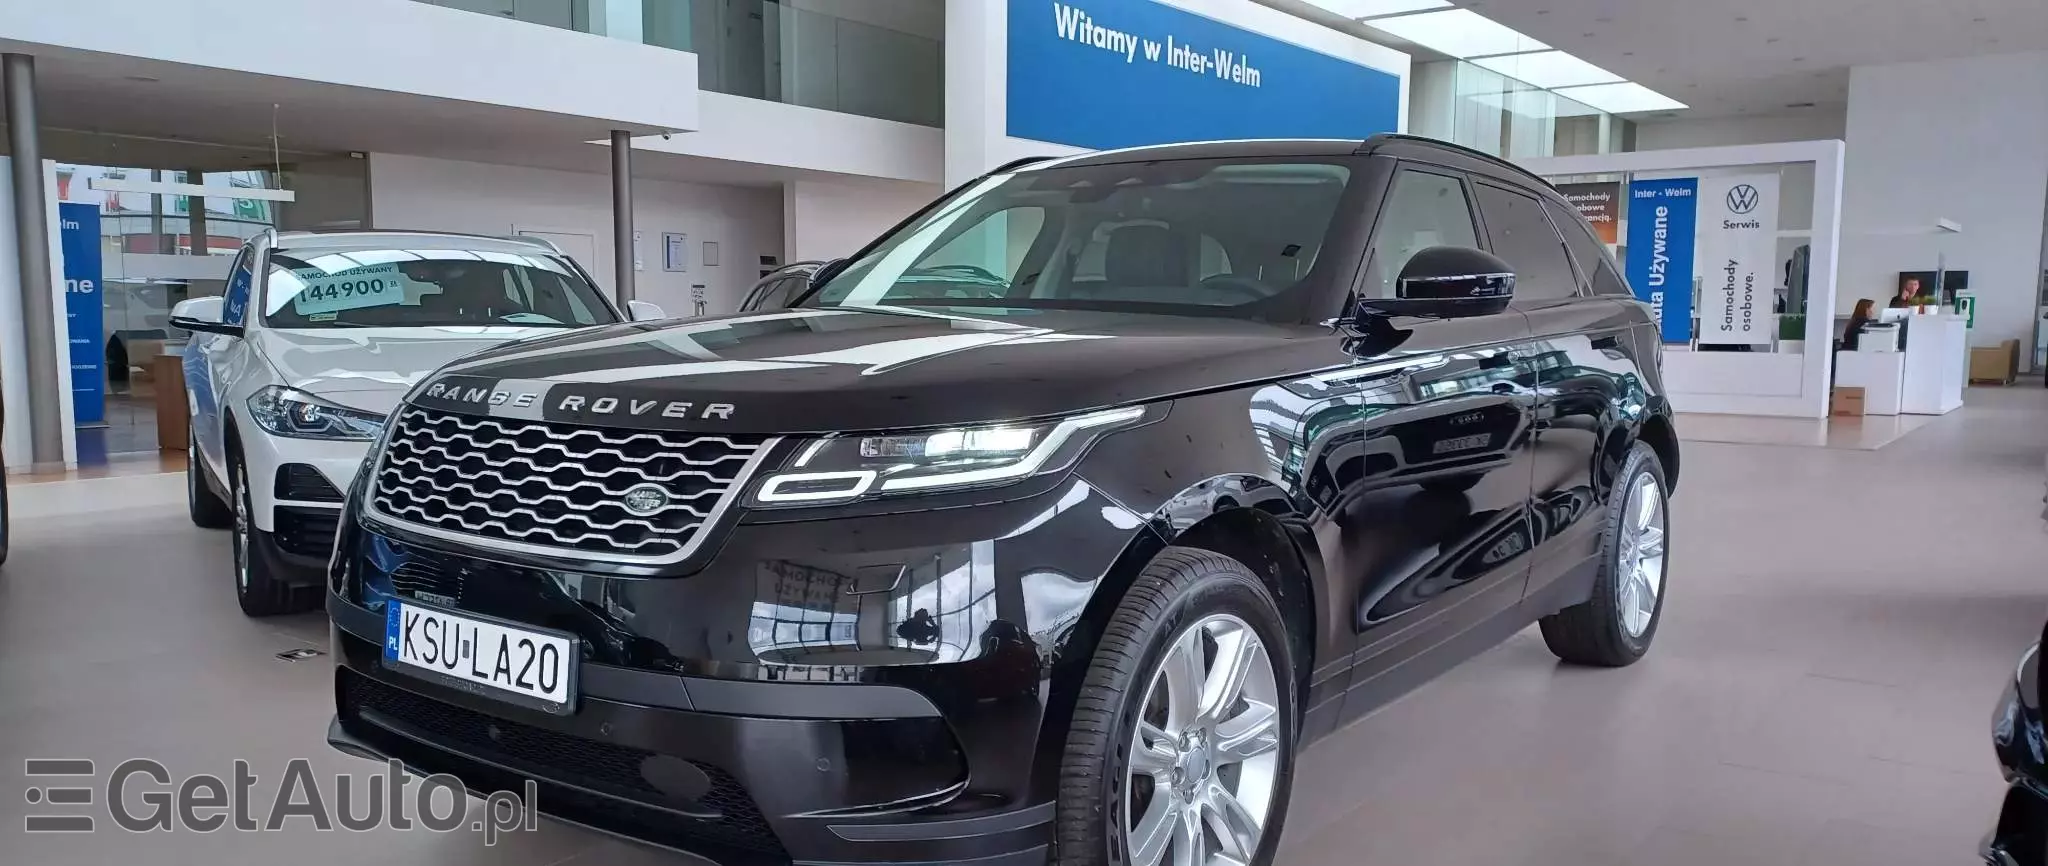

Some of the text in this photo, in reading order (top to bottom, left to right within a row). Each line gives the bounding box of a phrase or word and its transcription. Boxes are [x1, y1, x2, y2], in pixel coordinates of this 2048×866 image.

[1053, 2, 1262, 88] Witamy w Inter-Welm
[1564, 192, 1611, 202] Samochody
[1577, 203, 1605, 211] obowe
[1634, 189, 1657, 198] Inter
[1665, 188, 1692, 197] Welm
[1723, 219, 1760, 229] Serwis
[1648, 206, 1669, 286] Używane
[300, 278, 384, 302] 144900
[1721, 259, 1739, 332] Samochody
[1740, 272, 1754, 332] osobowe.
[426, 382, 736, 421] RANGE ROVER
[388, 636, 398, 651] PL
[403, 610, 560, 695] KSU LA20
